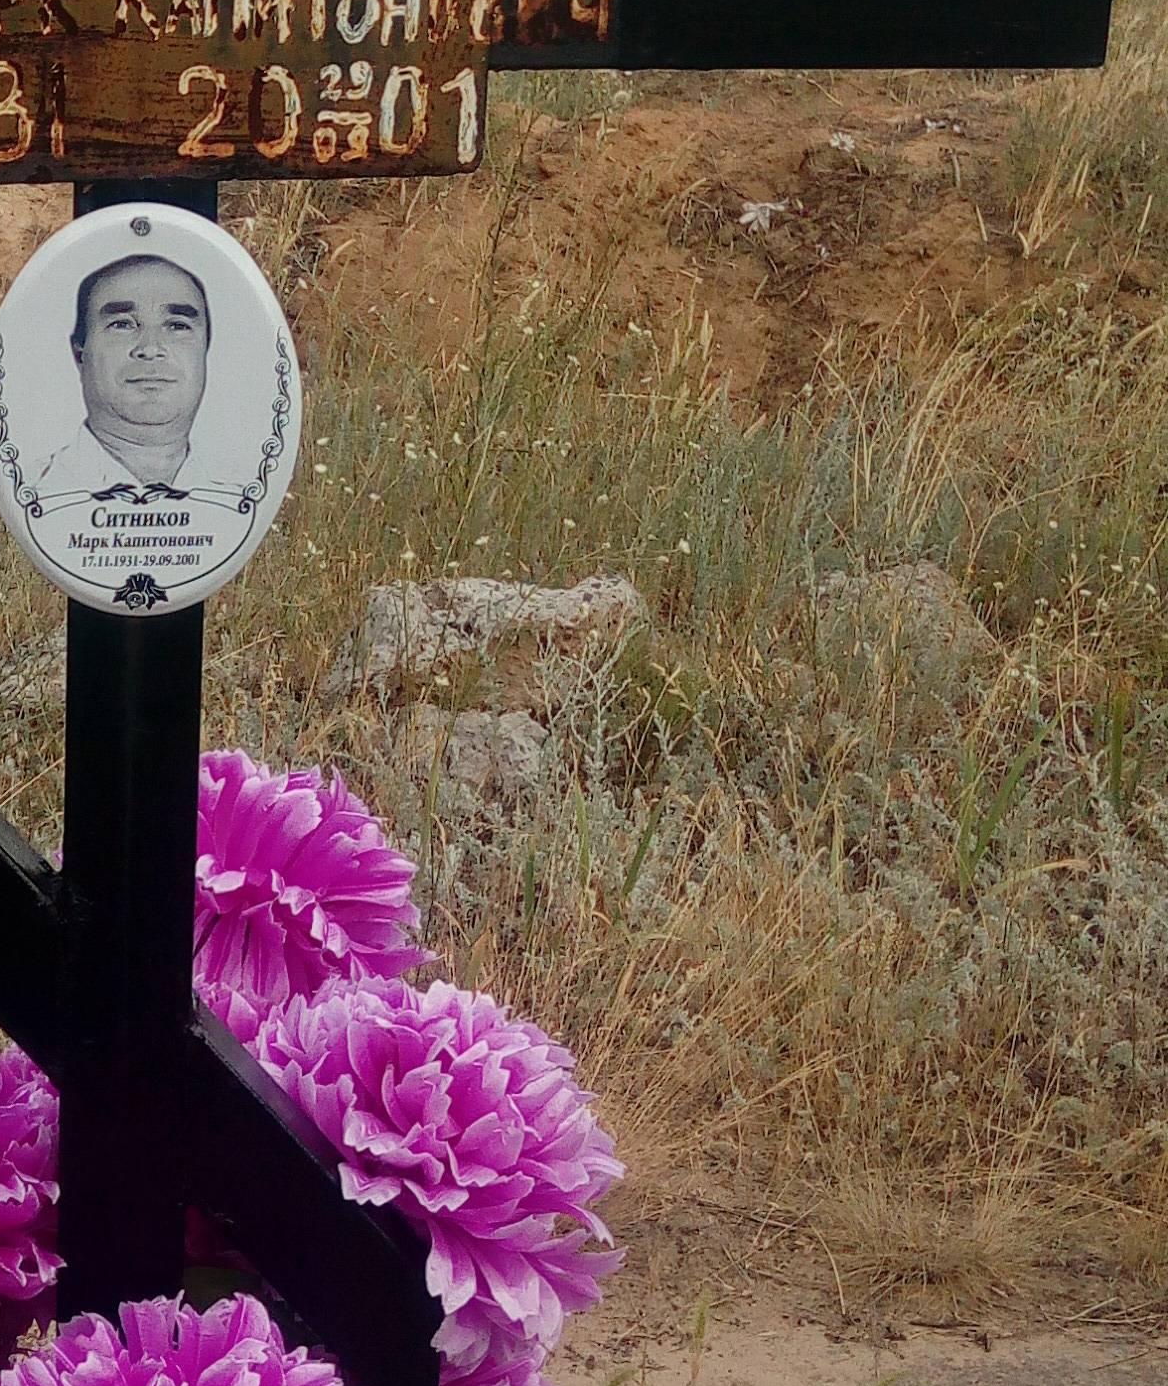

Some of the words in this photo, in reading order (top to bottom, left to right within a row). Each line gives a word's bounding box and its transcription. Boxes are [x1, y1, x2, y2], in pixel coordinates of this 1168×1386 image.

[91, 508, 190, 527] Ситников
[68, 533, 110, 553] Марк
[113, 534, 213, 549] Капитонович
